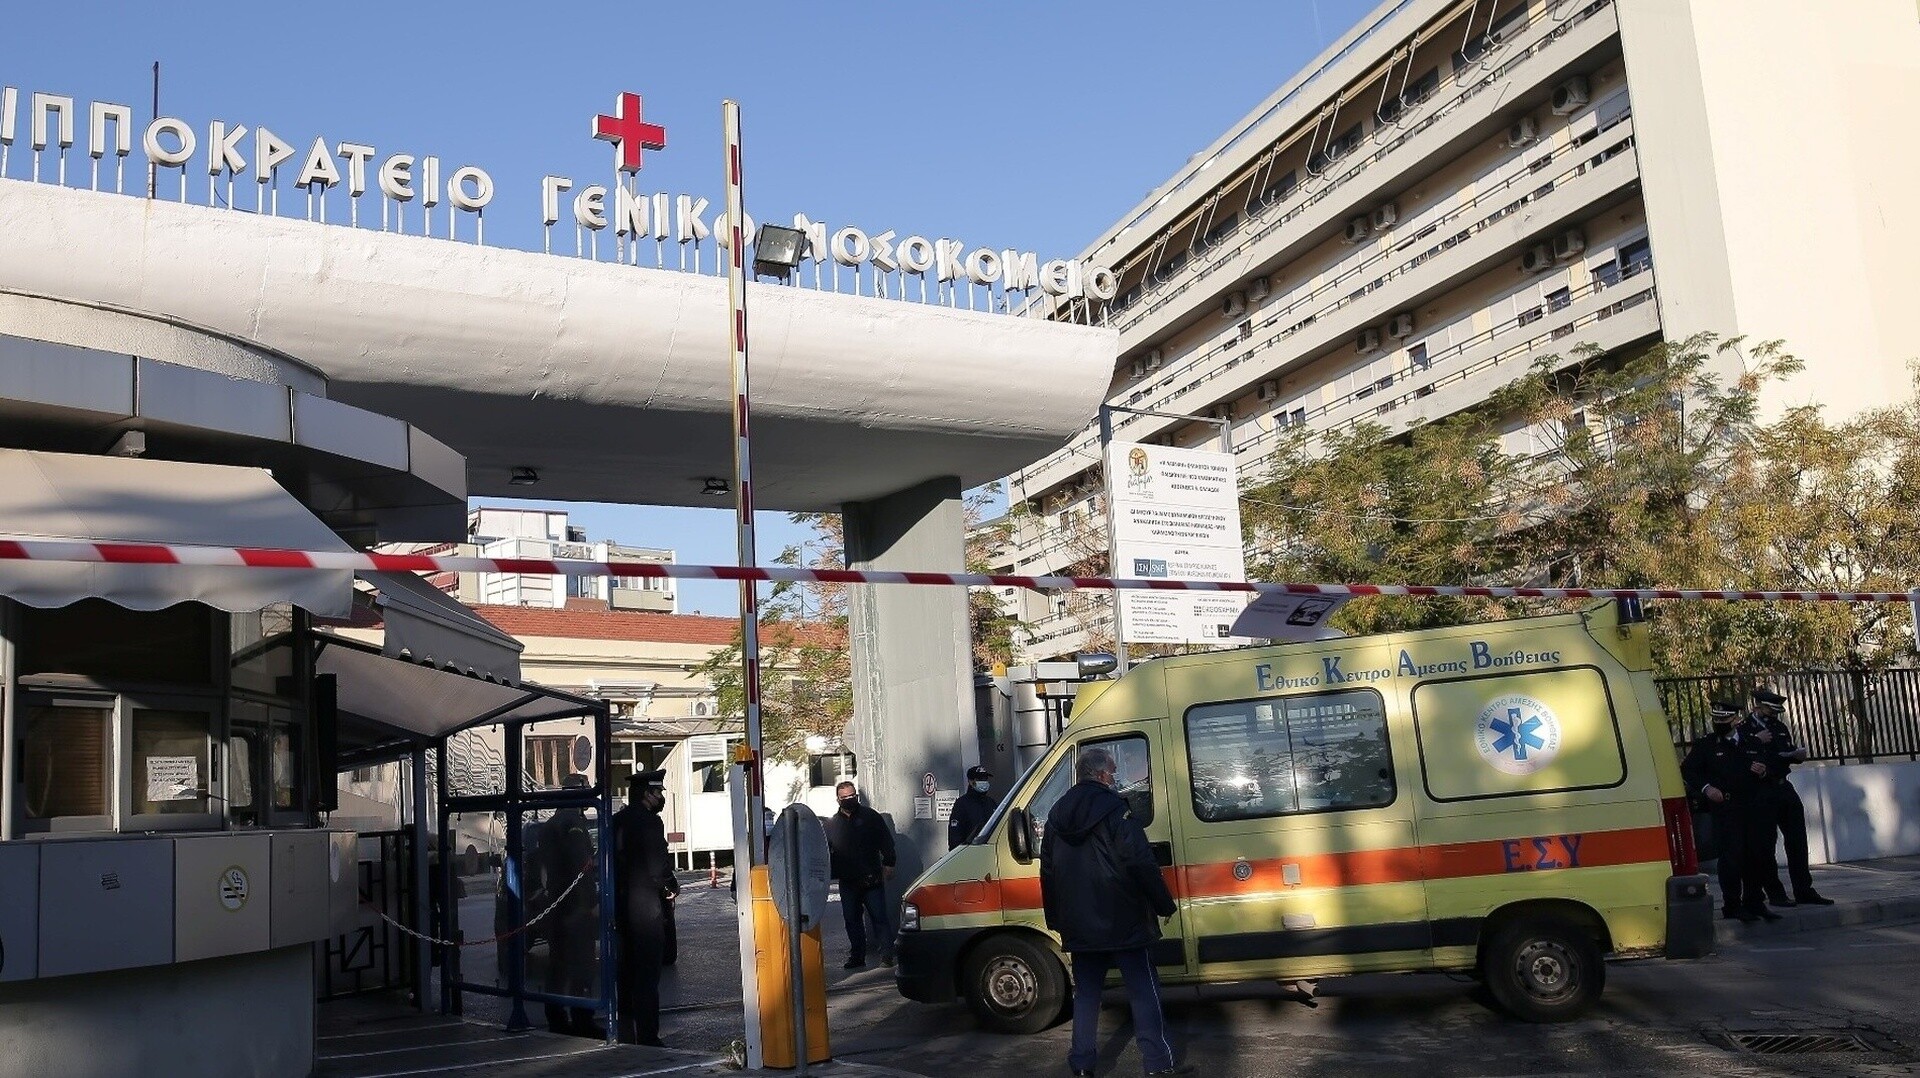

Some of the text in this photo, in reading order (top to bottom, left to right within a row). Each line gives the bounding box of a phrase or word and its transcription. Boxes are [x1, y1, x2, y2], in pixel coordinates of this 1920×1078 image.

[0, 87, 1116, 301] ΙΠΠΟΚΡΑΤΕΙΟ ΓΕΝΙΚΟ ΝΟΣΟΚΟΜΕΙΟ
[1255, 641, 1560, 692] Εθνικό Κεντρο Αμεσης Βοήθειας
